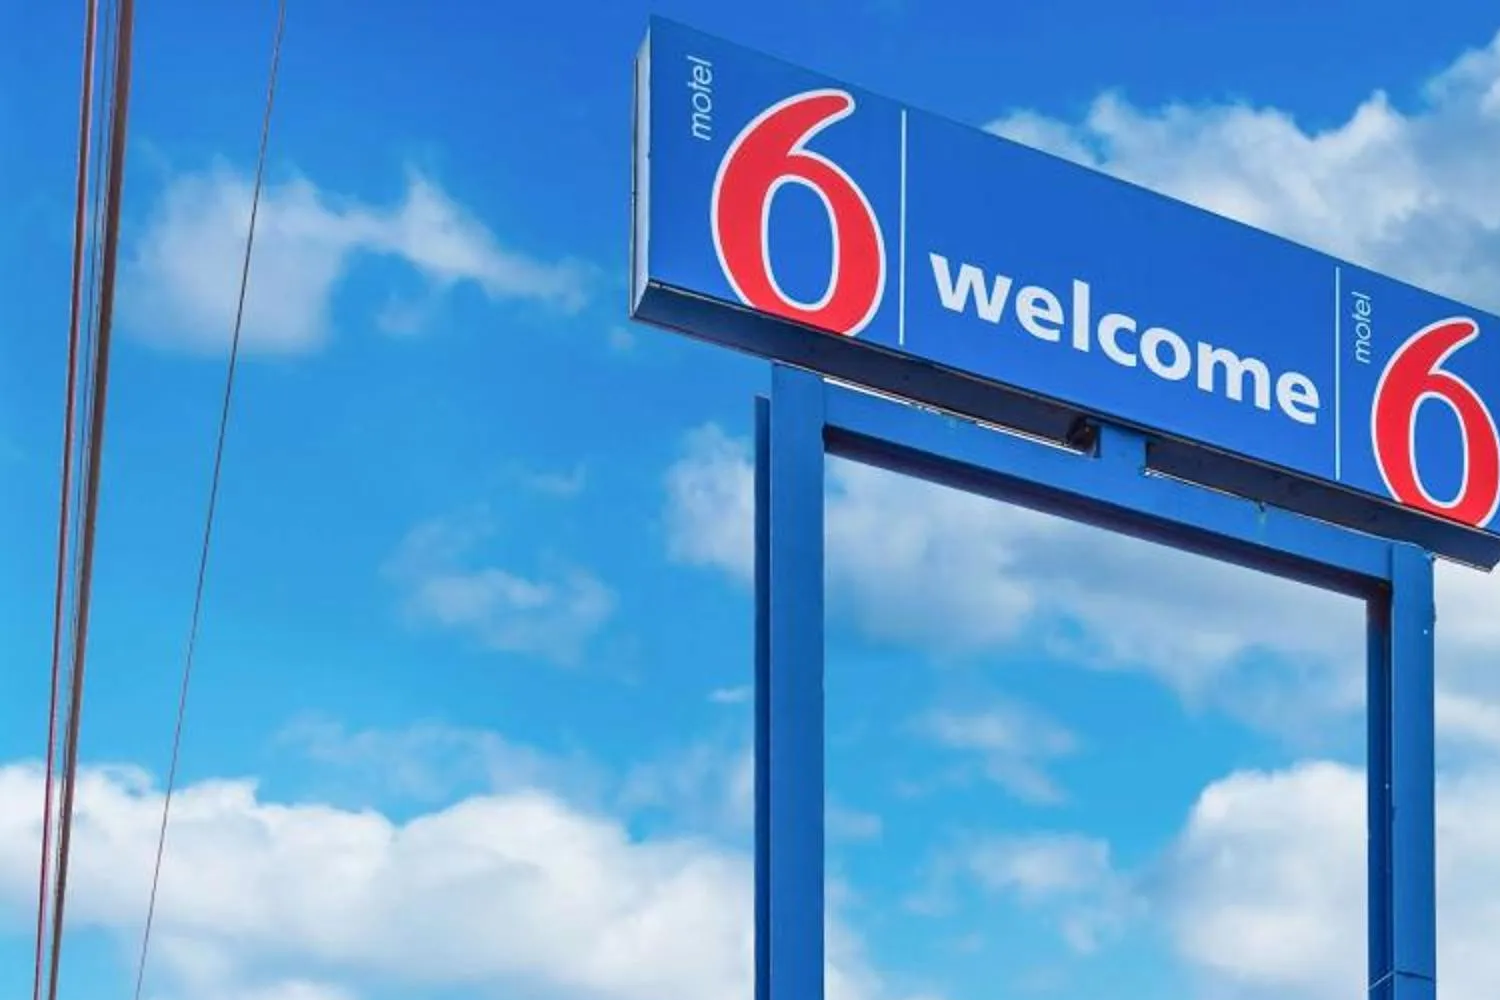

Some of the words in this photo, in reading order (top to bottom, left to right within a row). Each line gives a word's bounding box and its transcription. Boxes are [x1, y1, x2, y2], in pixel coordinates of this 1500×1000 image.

[687, 55, 713, 141] motel
[710, 88, 887, 337] 6
[929, 252, 1321, 425] welcome
[1351, 291, 1372, 364] motel
